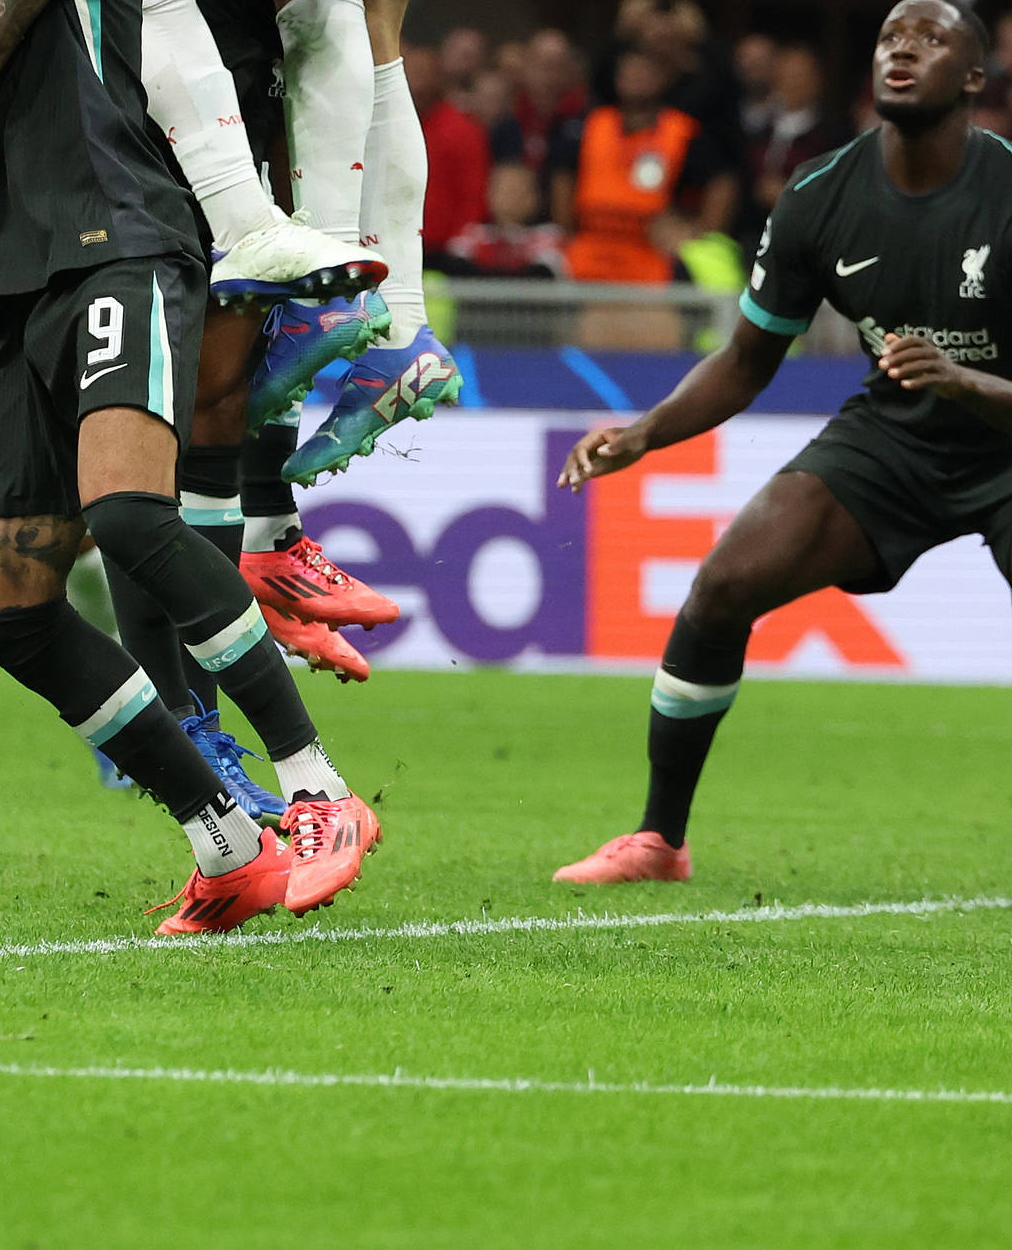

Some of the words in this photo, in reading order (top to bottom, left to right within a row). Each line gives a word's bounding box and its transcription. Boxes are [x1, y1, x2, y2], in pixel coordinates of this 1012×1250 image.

[959, 285, 986, 299] LFC
[87, 296, 124, 365] 9
[198, 806, 233, 858] DESIGN
